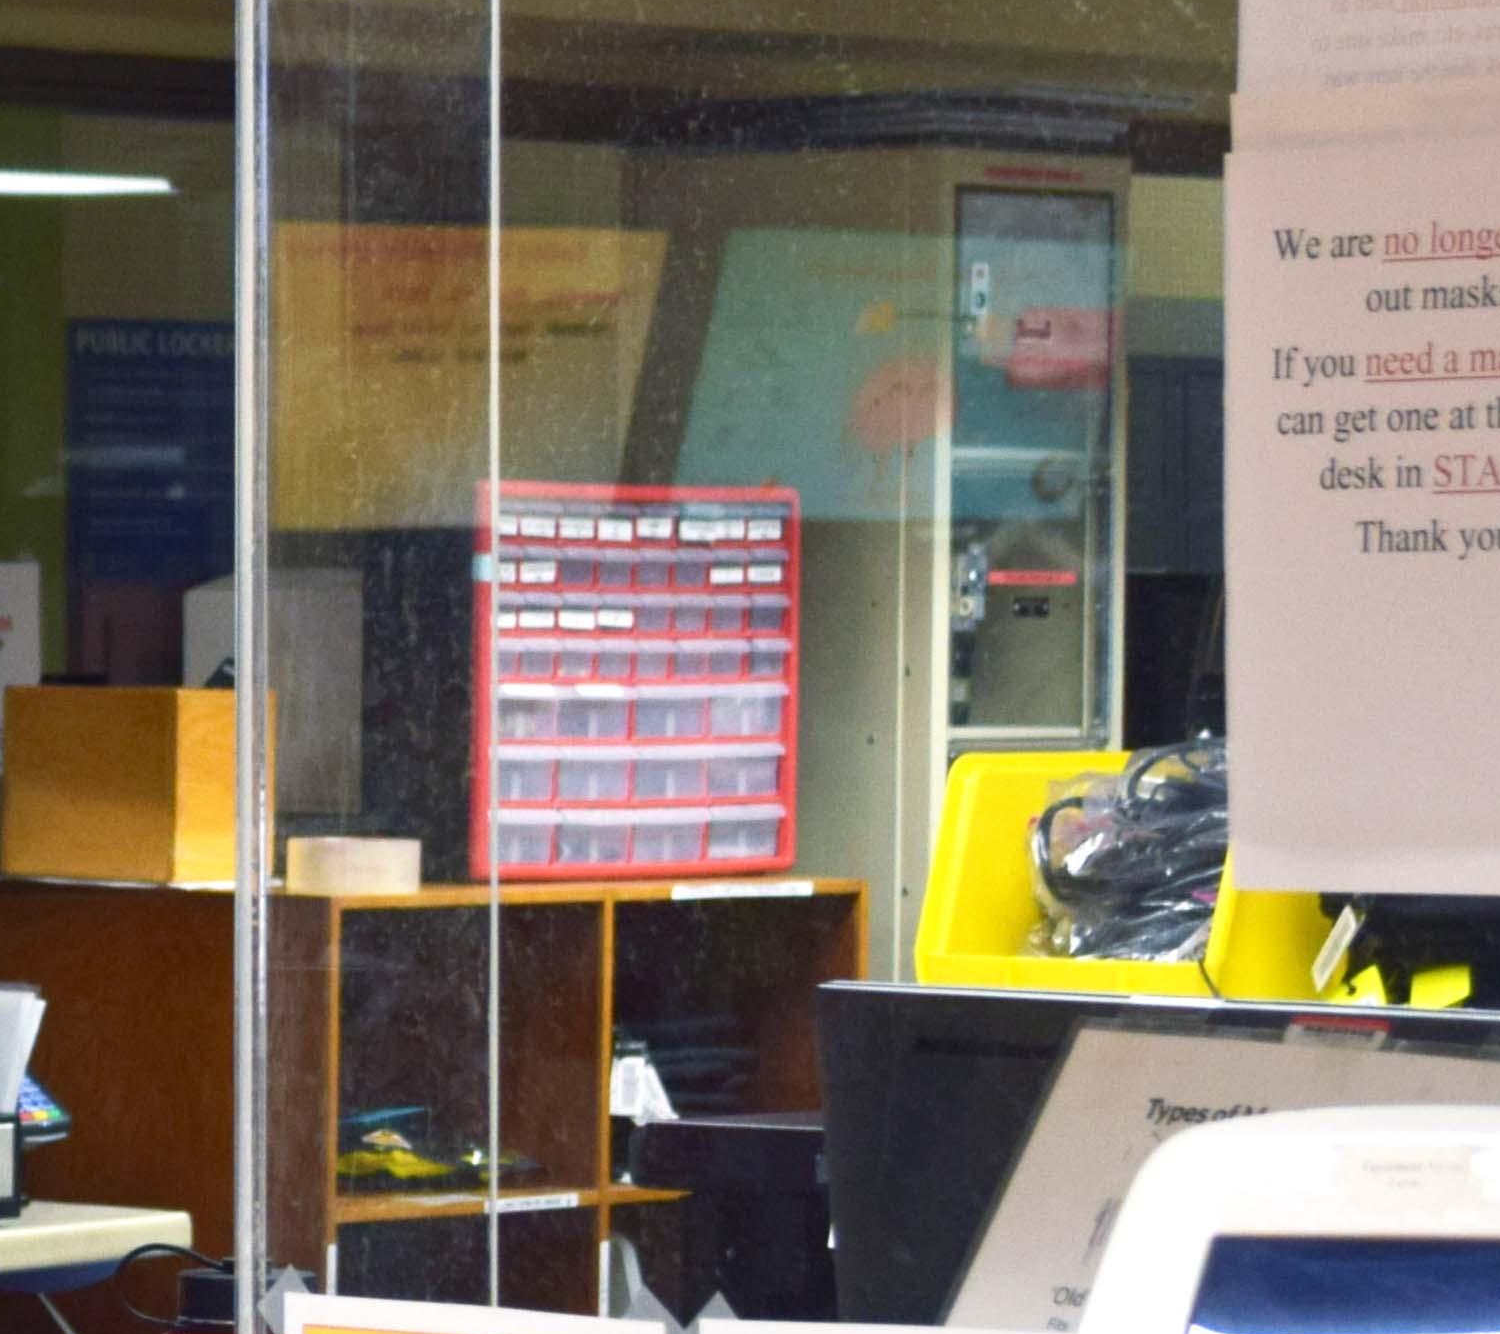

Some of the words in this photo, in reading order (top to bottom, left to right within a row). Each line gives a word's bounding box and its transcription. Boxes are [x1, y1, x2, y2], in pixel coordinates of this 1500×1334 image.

[1275, 228, 1320, 259] We
[1330, 234, 1373, 258] are
[1383, 231, 1418, 260] no
[1366, 282, 1410, 312] out
[1273, 347, 1298, 379] If
[1302, 353, 1356, 386] you
[1365, 342, 1433, 378] need
[1443, 354, 1458, 376] a
[1277, 410, 1324, 436] can
[1334, 405, 1384, 443] get
[1387, 405, 1438, 430] one
[1449, 402, 1476, 428] at
[1320, 456, 1384, 490] desk
[1396, 455, 1423, 488] in
[1356, 518, 1448, 553] Thank
[1147, 1098, 1208, 1125] Types
